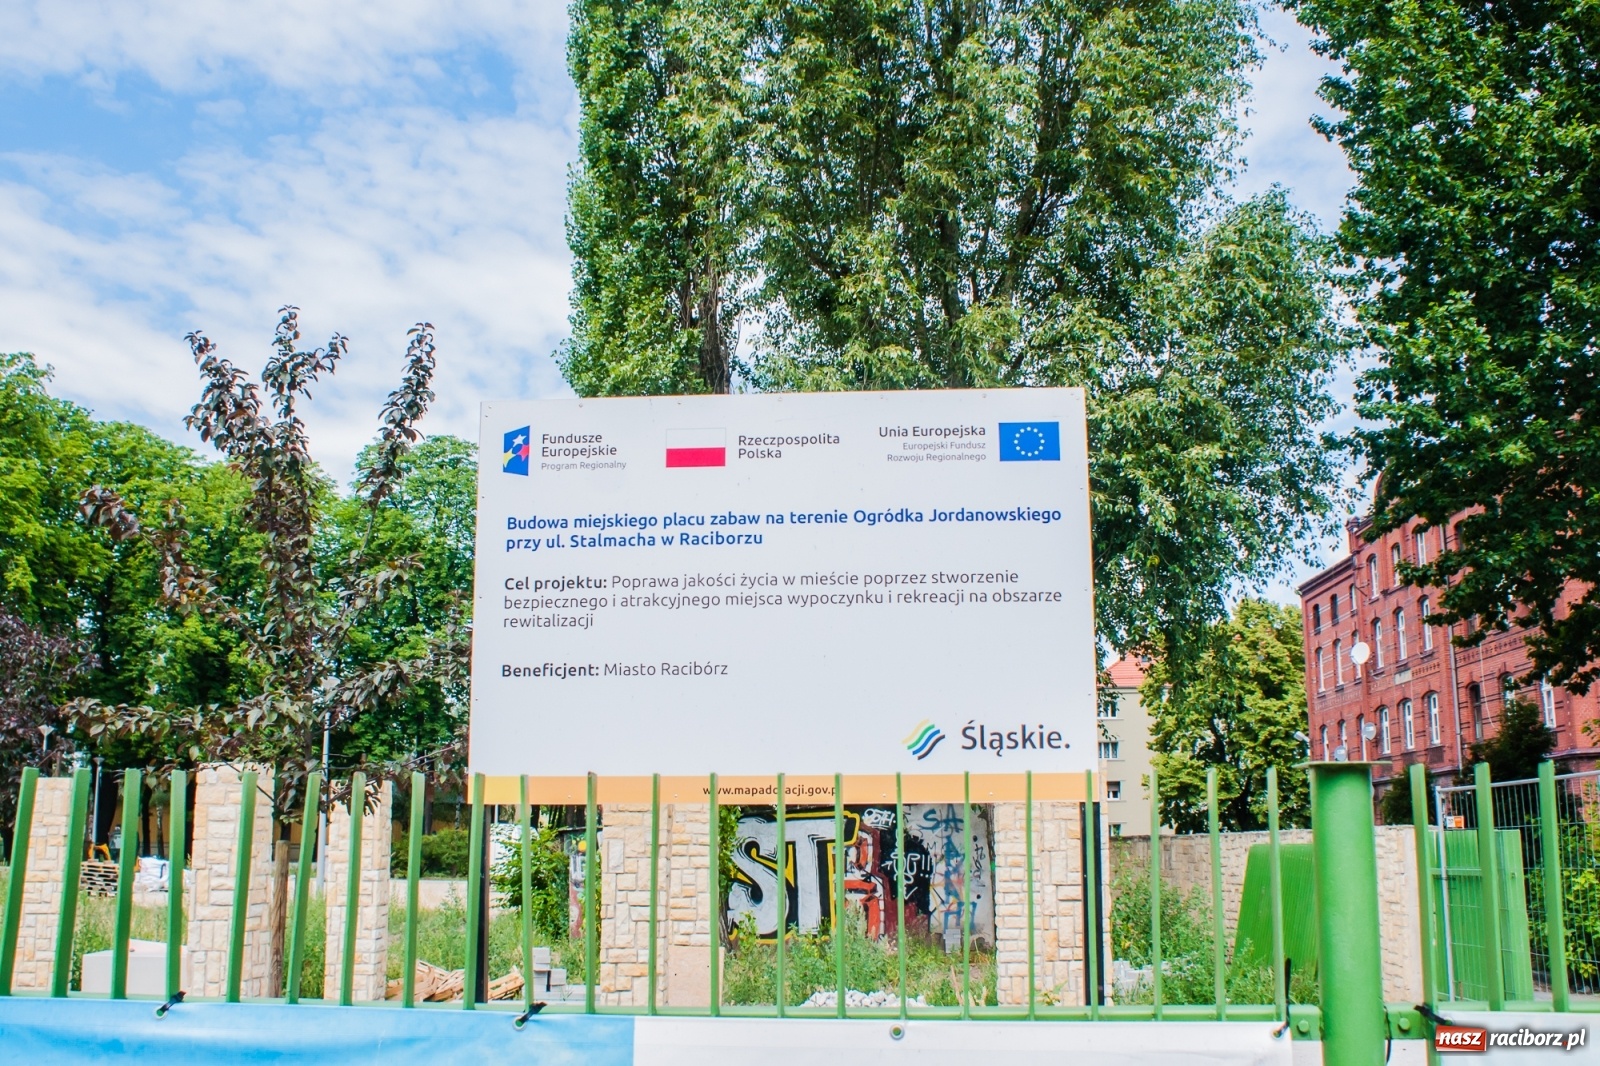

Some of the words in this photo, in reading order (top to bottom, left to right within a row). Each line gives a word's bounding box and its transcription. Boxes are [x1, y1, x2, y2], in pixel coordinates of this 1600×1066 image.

[541, 433, 603, 445] Fundusze
[878, 425, 909, 438] Unia
[912, 424, 986, 439] Europejska
[738, 433, 840, 448] Rzeczpospolita
[902, 441, 948, 451] Europejski
[949, 441, 986, 450] Fundusz
[541, 445, 617, 459] Europejskie
[738, 447, 782, 459] Polska
[887, 453, 925, 463] Rozwoju
[926, 452, 987, 463] Regionalnego
[541, 461, 578, 472] Program
[579, 460, 627, 471] Regionalny
[507, 514, 568, 530] Budowa
[573, 513, 658, 530] miejskiego
[663, 511, 705, 529] placu
[710, 510, 761, 526] zabaw
[765, 513, 785, 525] na
[789, 508, 848, 525] terenie
[853, 507, 924, 526] Ogródka
[928, 506, 1062, 524] Jordanowskiego
[506, 538, 542, 552] przy
[546, 533, 566, 549] ul.
[570, 532, 656, 548] Stalmacha
[661, 535, 675, 547] w
[679, 531, 763, 546] Raciborzu
[504, 576, 530, 590] Cel
[534, 575, 608, 592] projektu:
[611, 575, 679, 590] Poprawa
[682, 572, 736, 591] jakości
[740, 572, 778, 590] życia
[782, 575, 796, 586] w
[800, 571, 859, 586] mieście
[863, 573, 928, 587] poprzez
[931, 569, 1019, 584] stworzenie
[503, 594, 608, 611] bezpiecznego
[620, 592, 721, 609] atrakcyjnego
[725, 591, 783, 608] miejsca
[787, 589, 884, 607] wypoczynku
[896, 588, 965, 606] rekreacji
[969, 591, 988, 603] na
[991, 588, 1063, 603] obszarze
[503, 613, 594, 630] rewitalizacji
[501, 662, 600, 679] Beneficjent:
[603, 662, 657, 677] Miasto
[661, 660, 729, 677] Racibórz
[961, 719, 1071, 757] Śląskie.
[702, 784, 838, 798] ww.mapadoacji.gov.p
